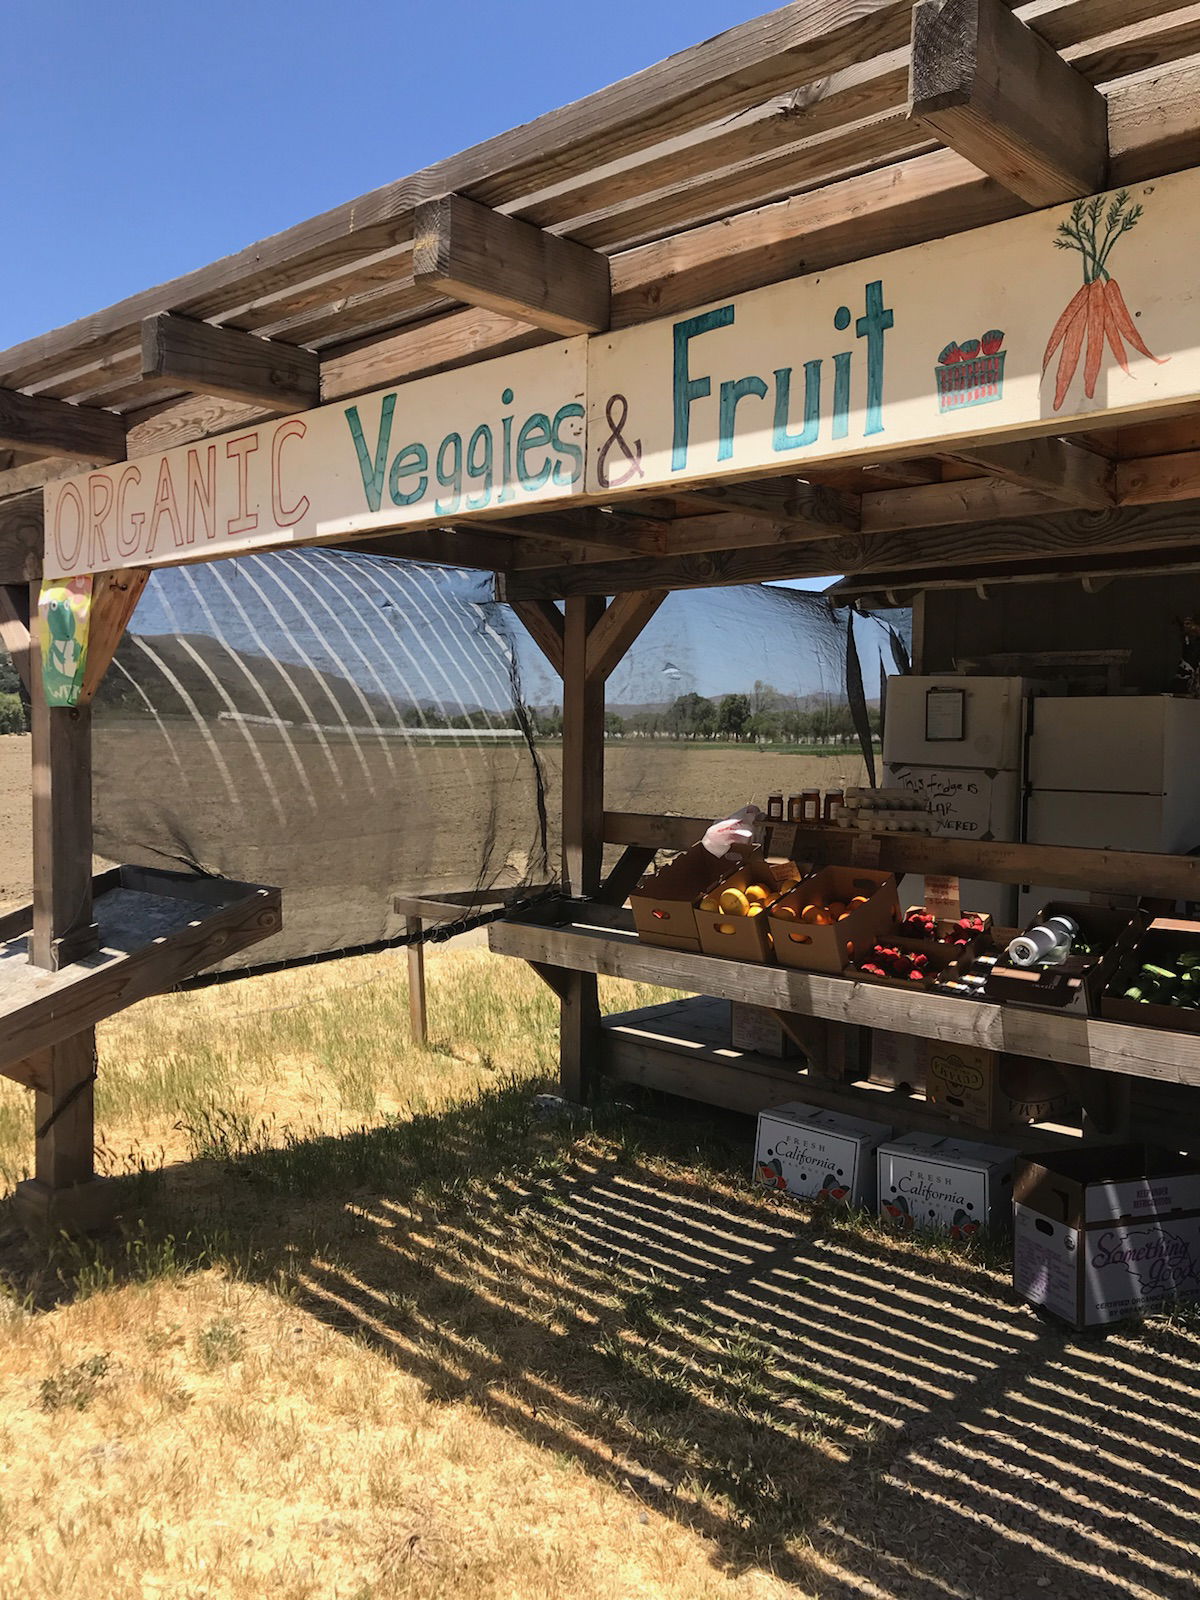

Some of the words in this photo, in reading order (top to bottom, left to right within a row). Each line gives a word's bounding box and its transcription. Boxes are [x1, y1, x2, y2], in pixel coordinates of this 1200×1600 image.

[53, 419, 310, 571] ORGANIC
[345, 387, 586, 517] Veggies
[597, 393, 644, 488] &
[671, 279, 894, 471] Fruit
[775, 1140, 836, 1171] California
[786, 1136, 826, 1152] FRESH
[898, 1177, 965, 1205] California
[909, 1170, 952, 1185] FRESH
[1091, 1232, 1190, 1269] Something
